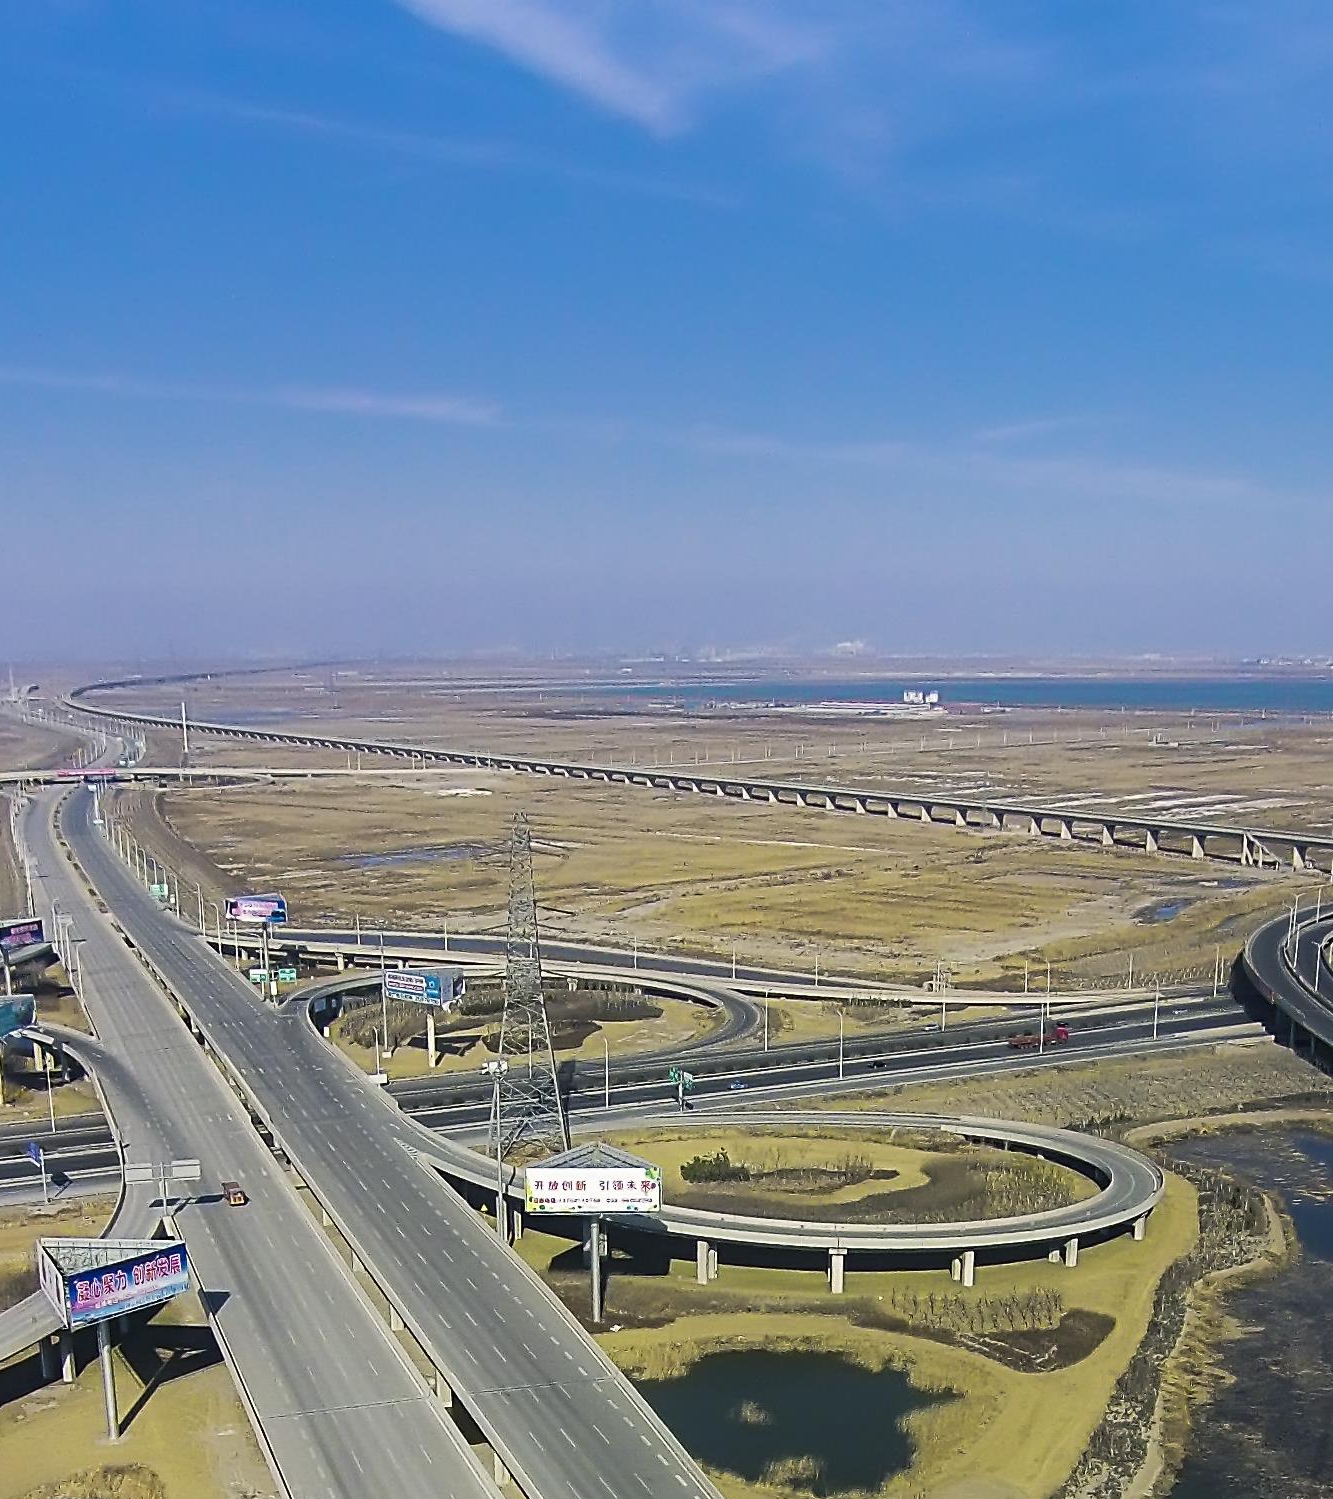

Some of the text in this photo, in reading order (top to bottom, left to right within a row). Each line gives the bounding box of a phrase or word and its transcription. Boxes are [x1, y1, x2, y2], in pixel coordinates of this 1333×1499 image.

[534, 1180, 651, 1193] 开放创新 引领未来
[132, 1254, 182, 1286] 创新发展
